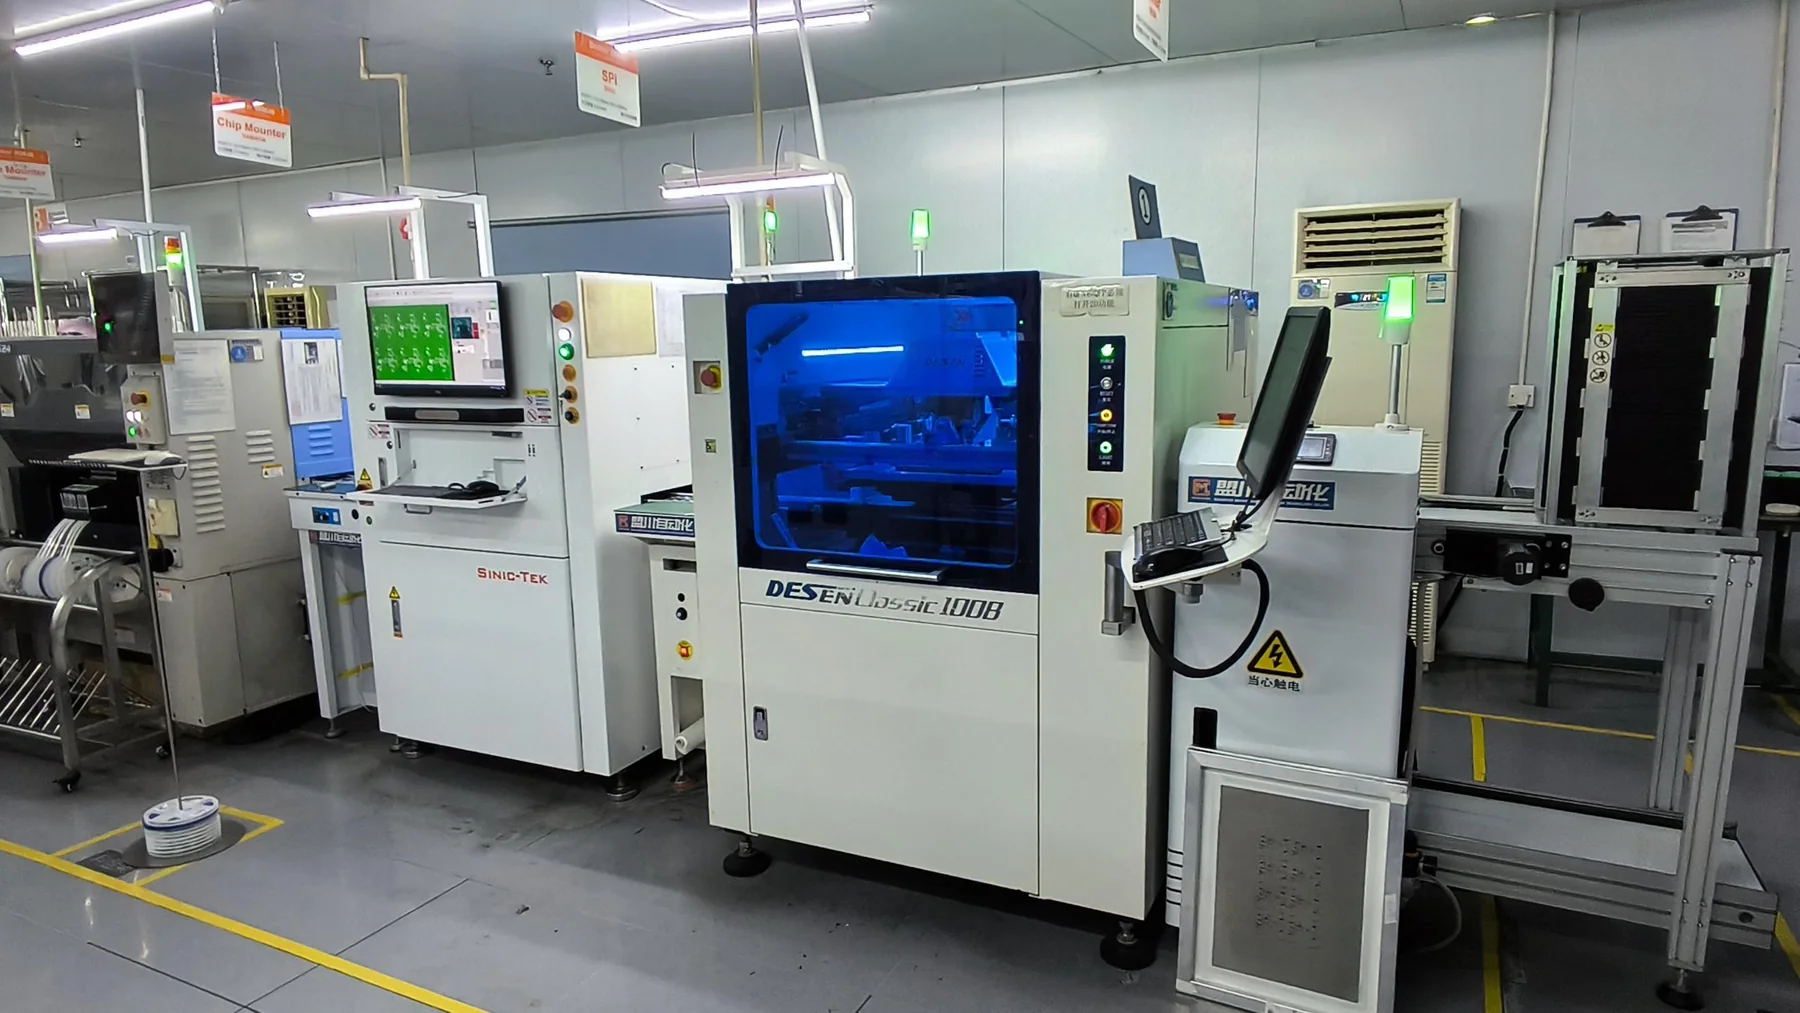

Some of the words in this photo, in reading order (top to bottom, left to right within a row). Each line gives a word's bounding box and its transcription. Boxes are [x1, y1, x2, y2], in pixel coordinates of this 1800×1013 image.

[602, 69, 618, 86] SPI
[217, 117, 242, 131] Chip
[245, 122, 287, 139] Mounter
[765, 579, 854, 605] DESEN
[1248, 675, 1300, 691] 当心触电
